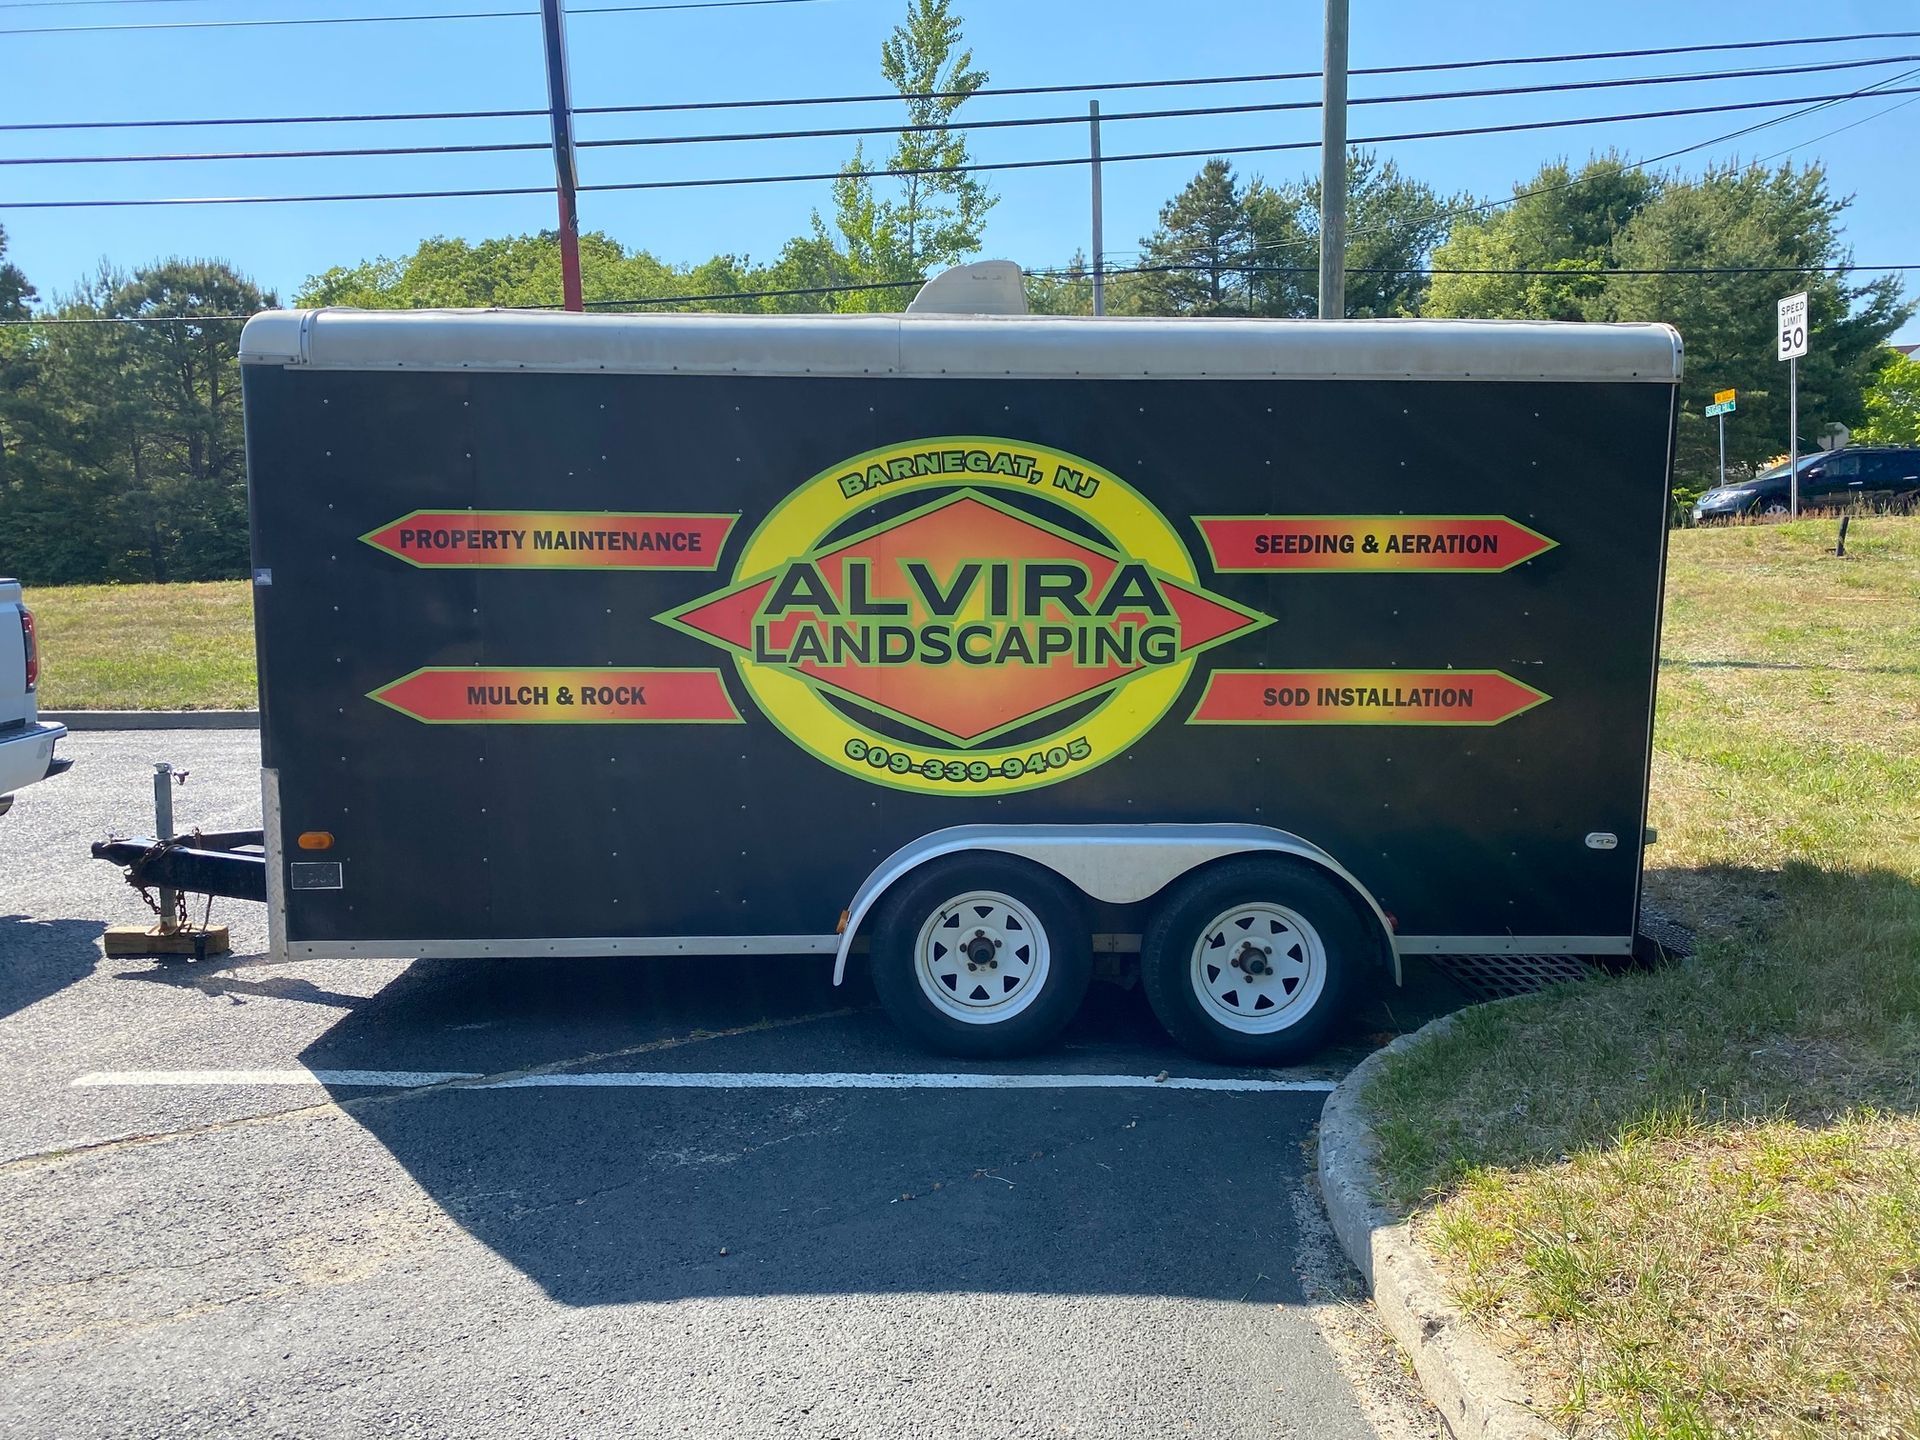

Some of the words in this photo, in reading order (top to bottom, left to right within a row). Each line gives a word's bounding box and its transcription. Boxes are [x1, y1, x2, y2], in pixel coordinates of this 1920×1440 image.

[1781, 301, 1805, 316] SPEED
[1783, 314, 1802, 328] LIMIT
[1782, 327, 1804, 352] 50
[838, 450, 1043, 499] BARNEGAT,
[1052, 465, 1100, 499] NJ
[400, 529, 526, 549] PROPERTY
[533, 530, 702, 552] MAINTENANCE
[1254, 534, 1355, 554] SEEDING
[1361, 534, 1379, 554] &
[1385, 534, 1498, 554] AERATION
[763, 562, 1171, 616] ALVIRA
[755, 625, 1177, 665] LANDSCAPING
[467, 686, 549, 705] MULCH
[555, 686, 574, 705] &
[580, 686, 647, 705] ROCK
[1263, 687, 1310, 706] SOD
[1316, 687, 1474, 707] INSTALLATION
[844, 736, 1092, 782] 609-339-9405
